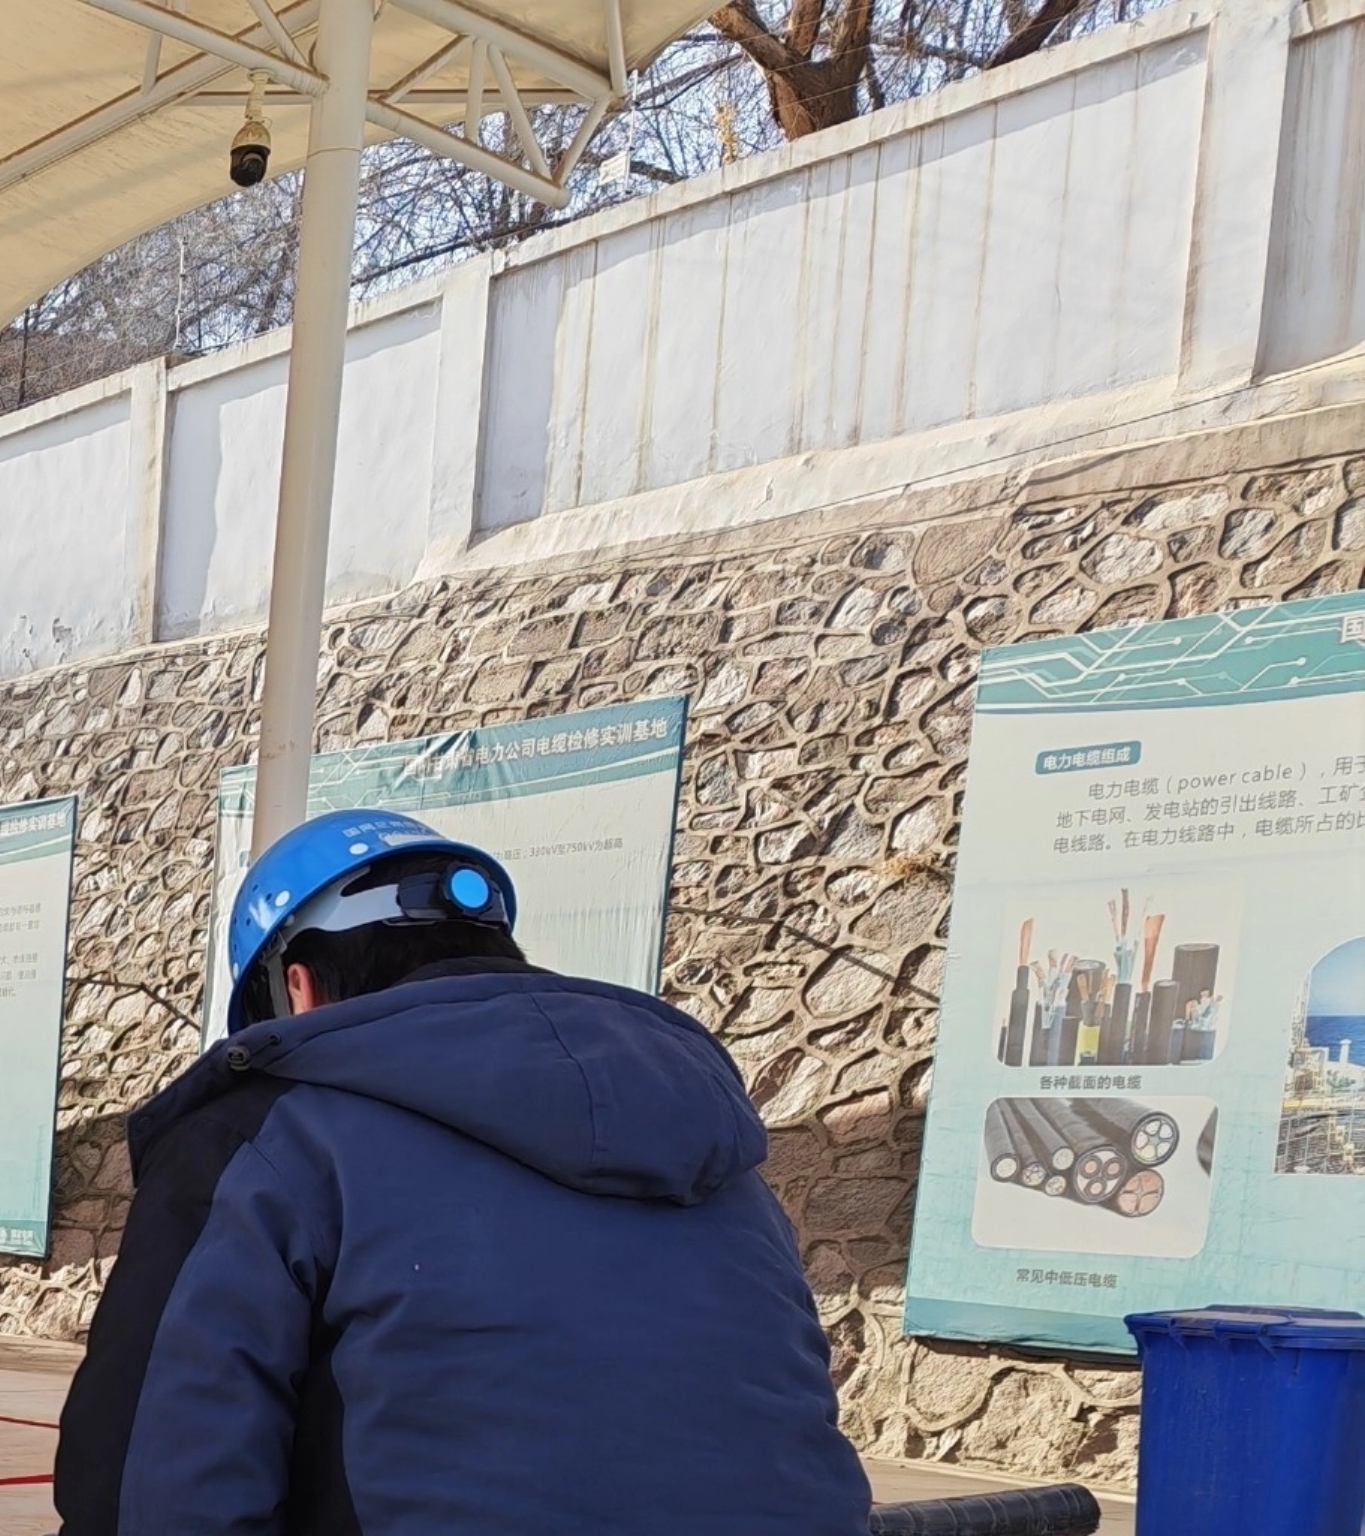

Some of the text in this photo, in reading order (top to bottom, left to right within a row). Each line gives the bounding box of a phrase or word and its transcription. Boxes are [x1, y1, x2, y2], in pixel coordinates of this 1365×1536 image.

[1043, 746, 1131, 770] 电力电缆组成
[1056, 783, 1365, 829] 地下电网、发电站的引出线路、工矿
[1040, 1075, 1142, 1090] 各种截面的电缆
[1016, 1267, 1119, 1289] 常见中低压电缆
